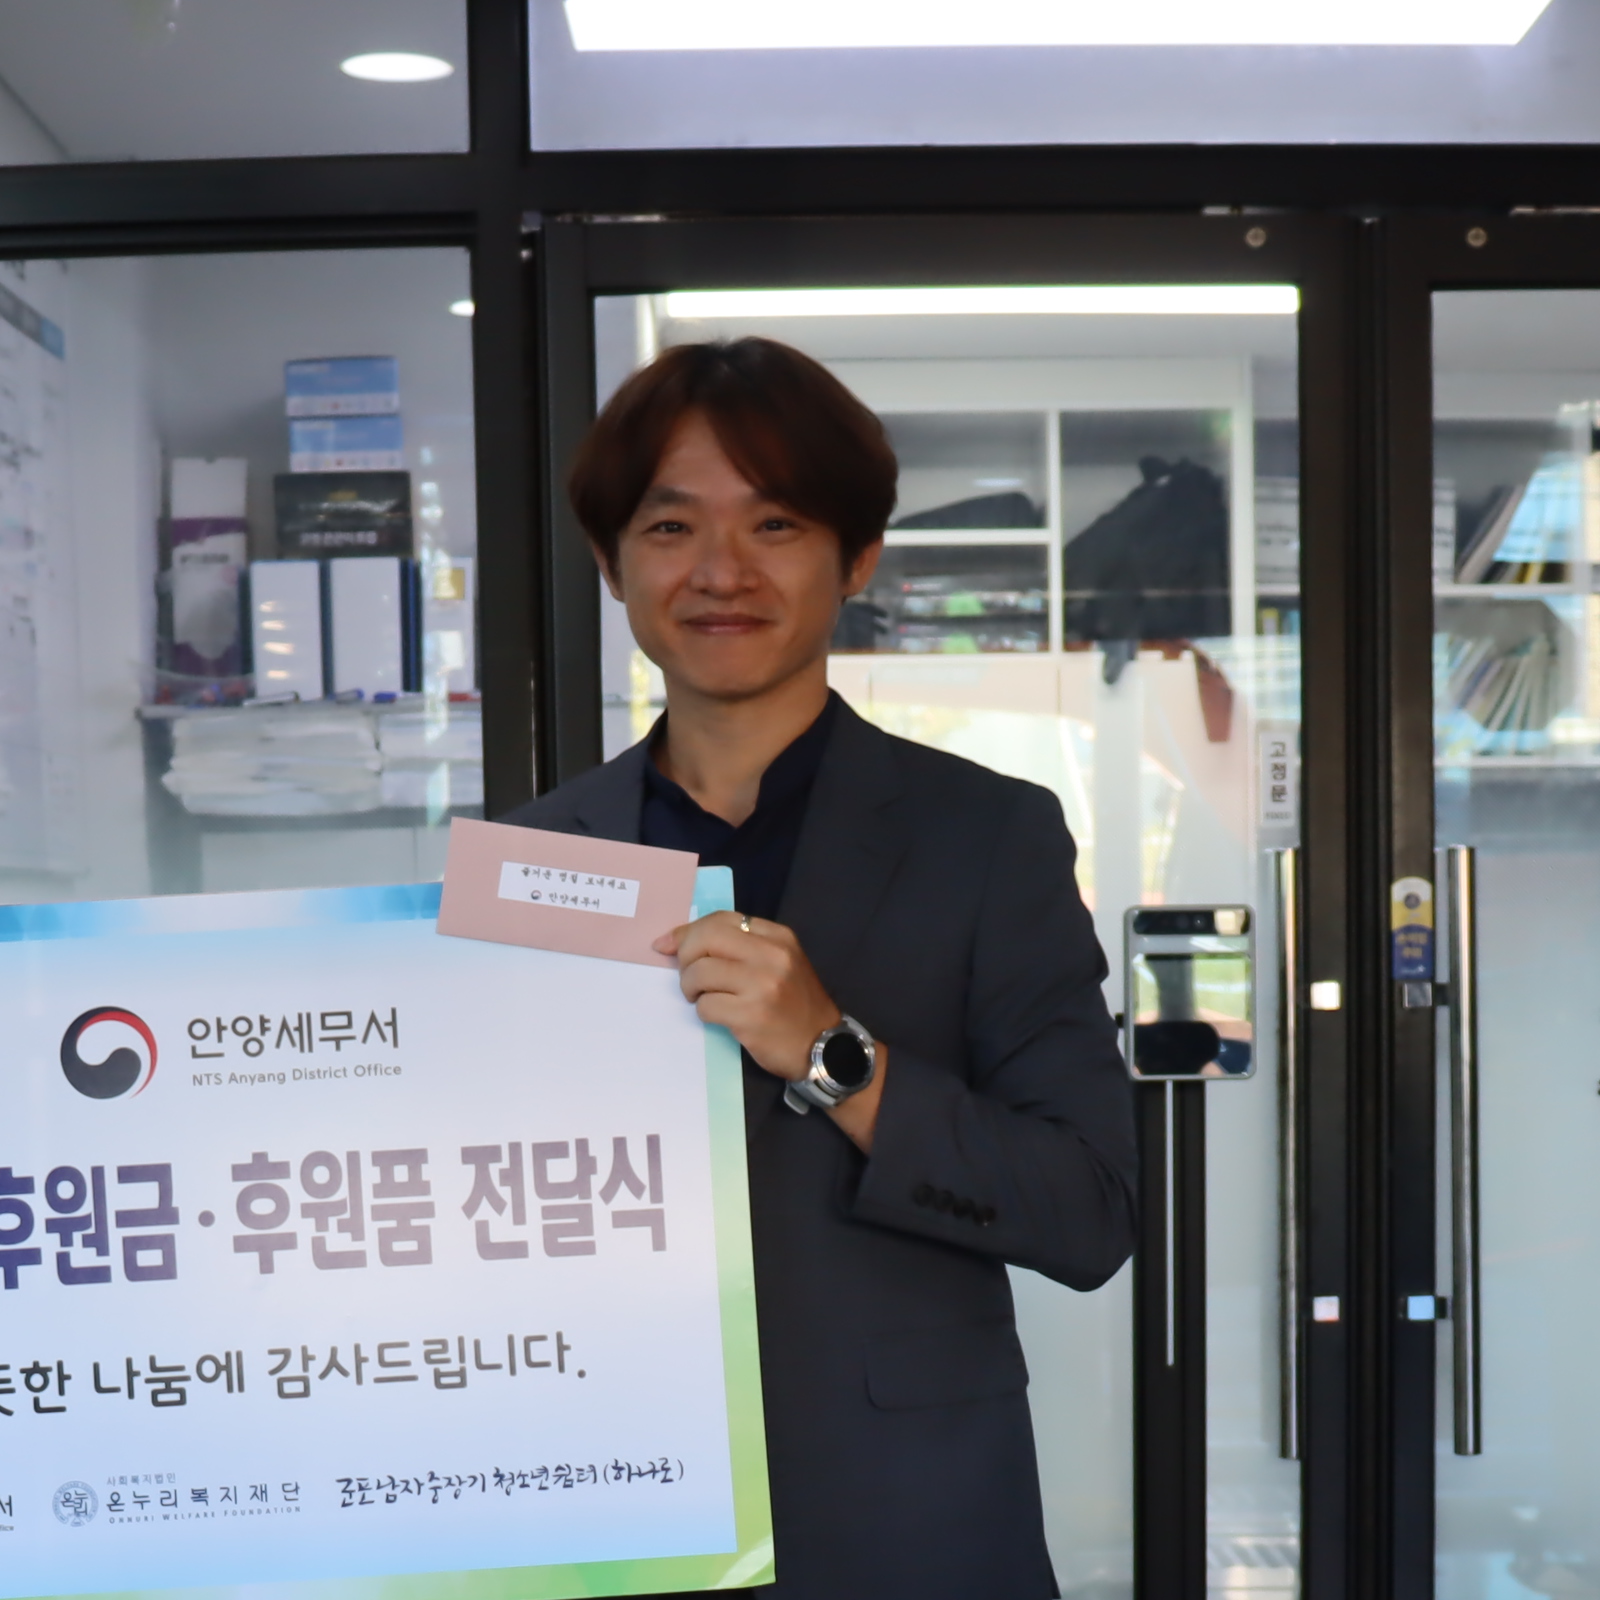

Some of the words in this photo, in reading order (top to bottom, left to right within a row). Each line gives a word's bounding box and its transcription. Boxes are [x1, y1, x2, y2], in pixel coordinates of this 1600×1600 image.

[187, 1007, 399, 1059] 안양세무서
[192, 1073, 223, 1086] NTS
[228, 1069, 287, 1086] Anyang
[292, 1066, 349, 1081] District
[353, 1063, 403, 1078] Office
[459, 1133, 668, 1262] 전달식
[92, 1348, 247, 1408] 나눔에
[267, 1330, 588, 1398] 감사드립니다.
